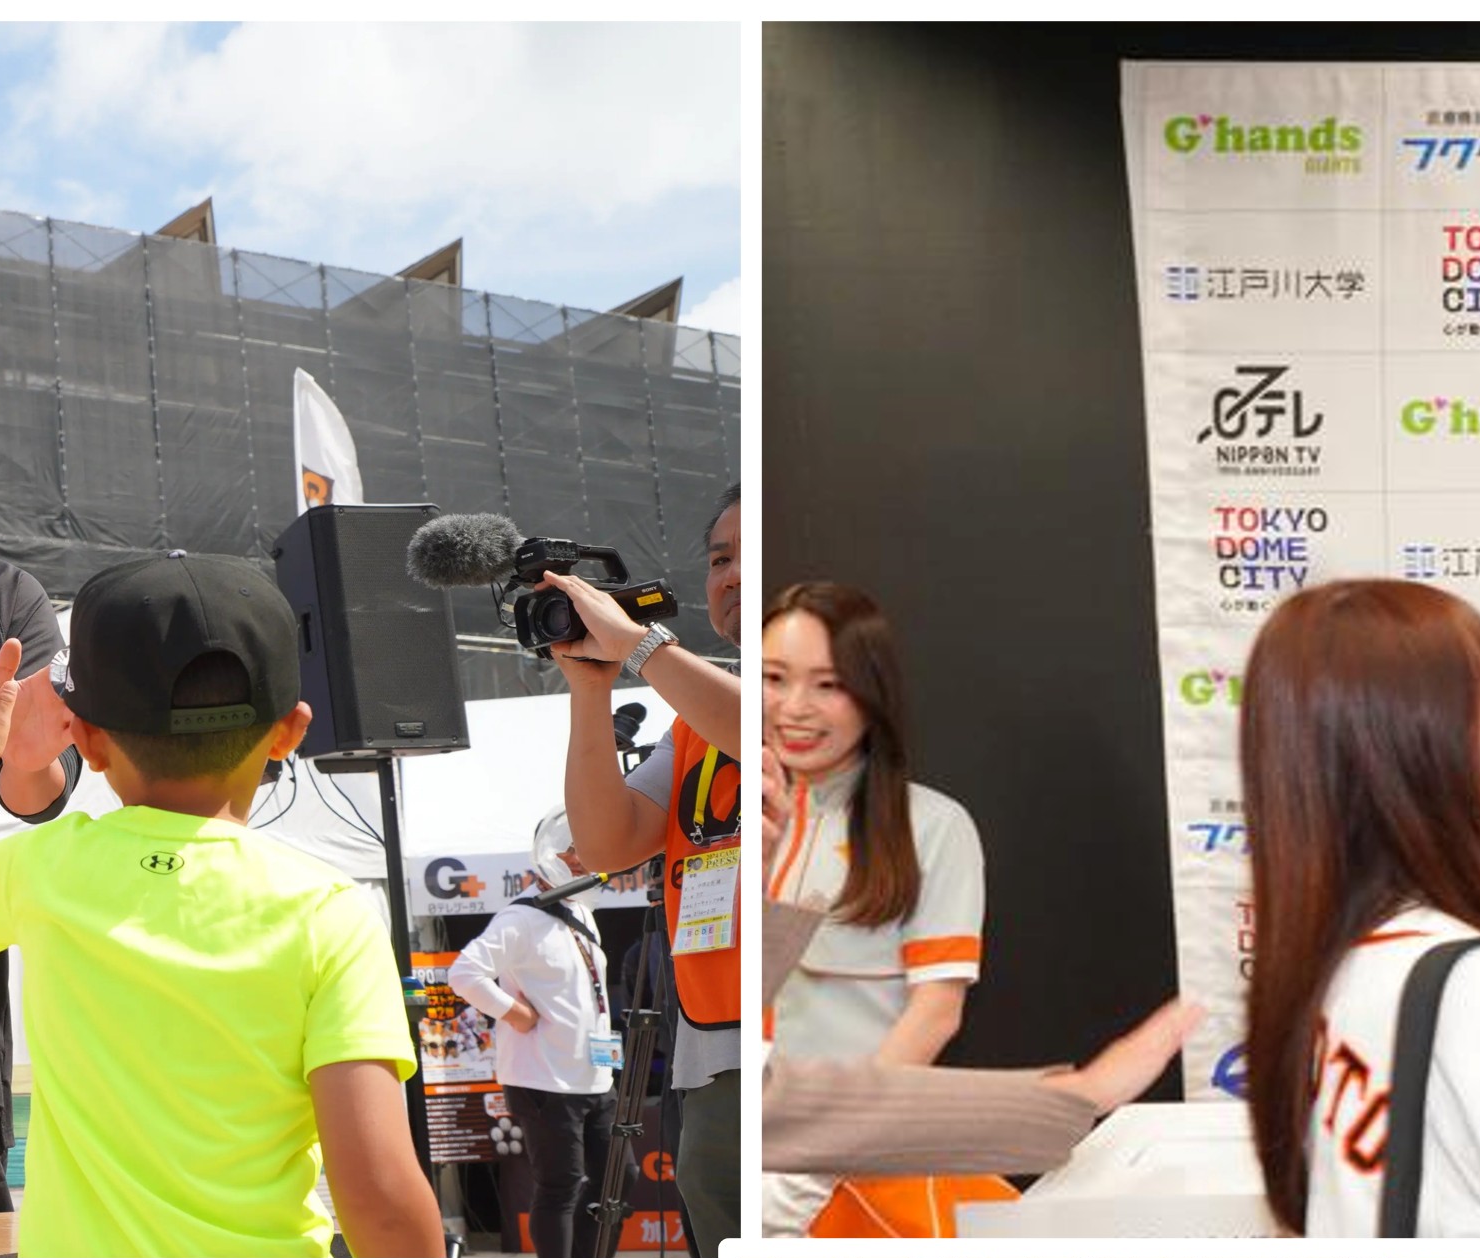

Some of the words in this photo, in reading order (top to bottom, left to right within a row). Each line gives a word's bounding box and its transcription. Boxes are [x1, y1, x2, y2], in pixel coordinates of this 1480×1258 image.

[1207, 269, 1365, 299] 江戸川大学
[1296, 446, 1321, 464] TV
[1214, 507, 1328, 533] TOKYO
[1215, 537, 1307, 562] DOME
[1219, 565, 1307, 590] CITY
